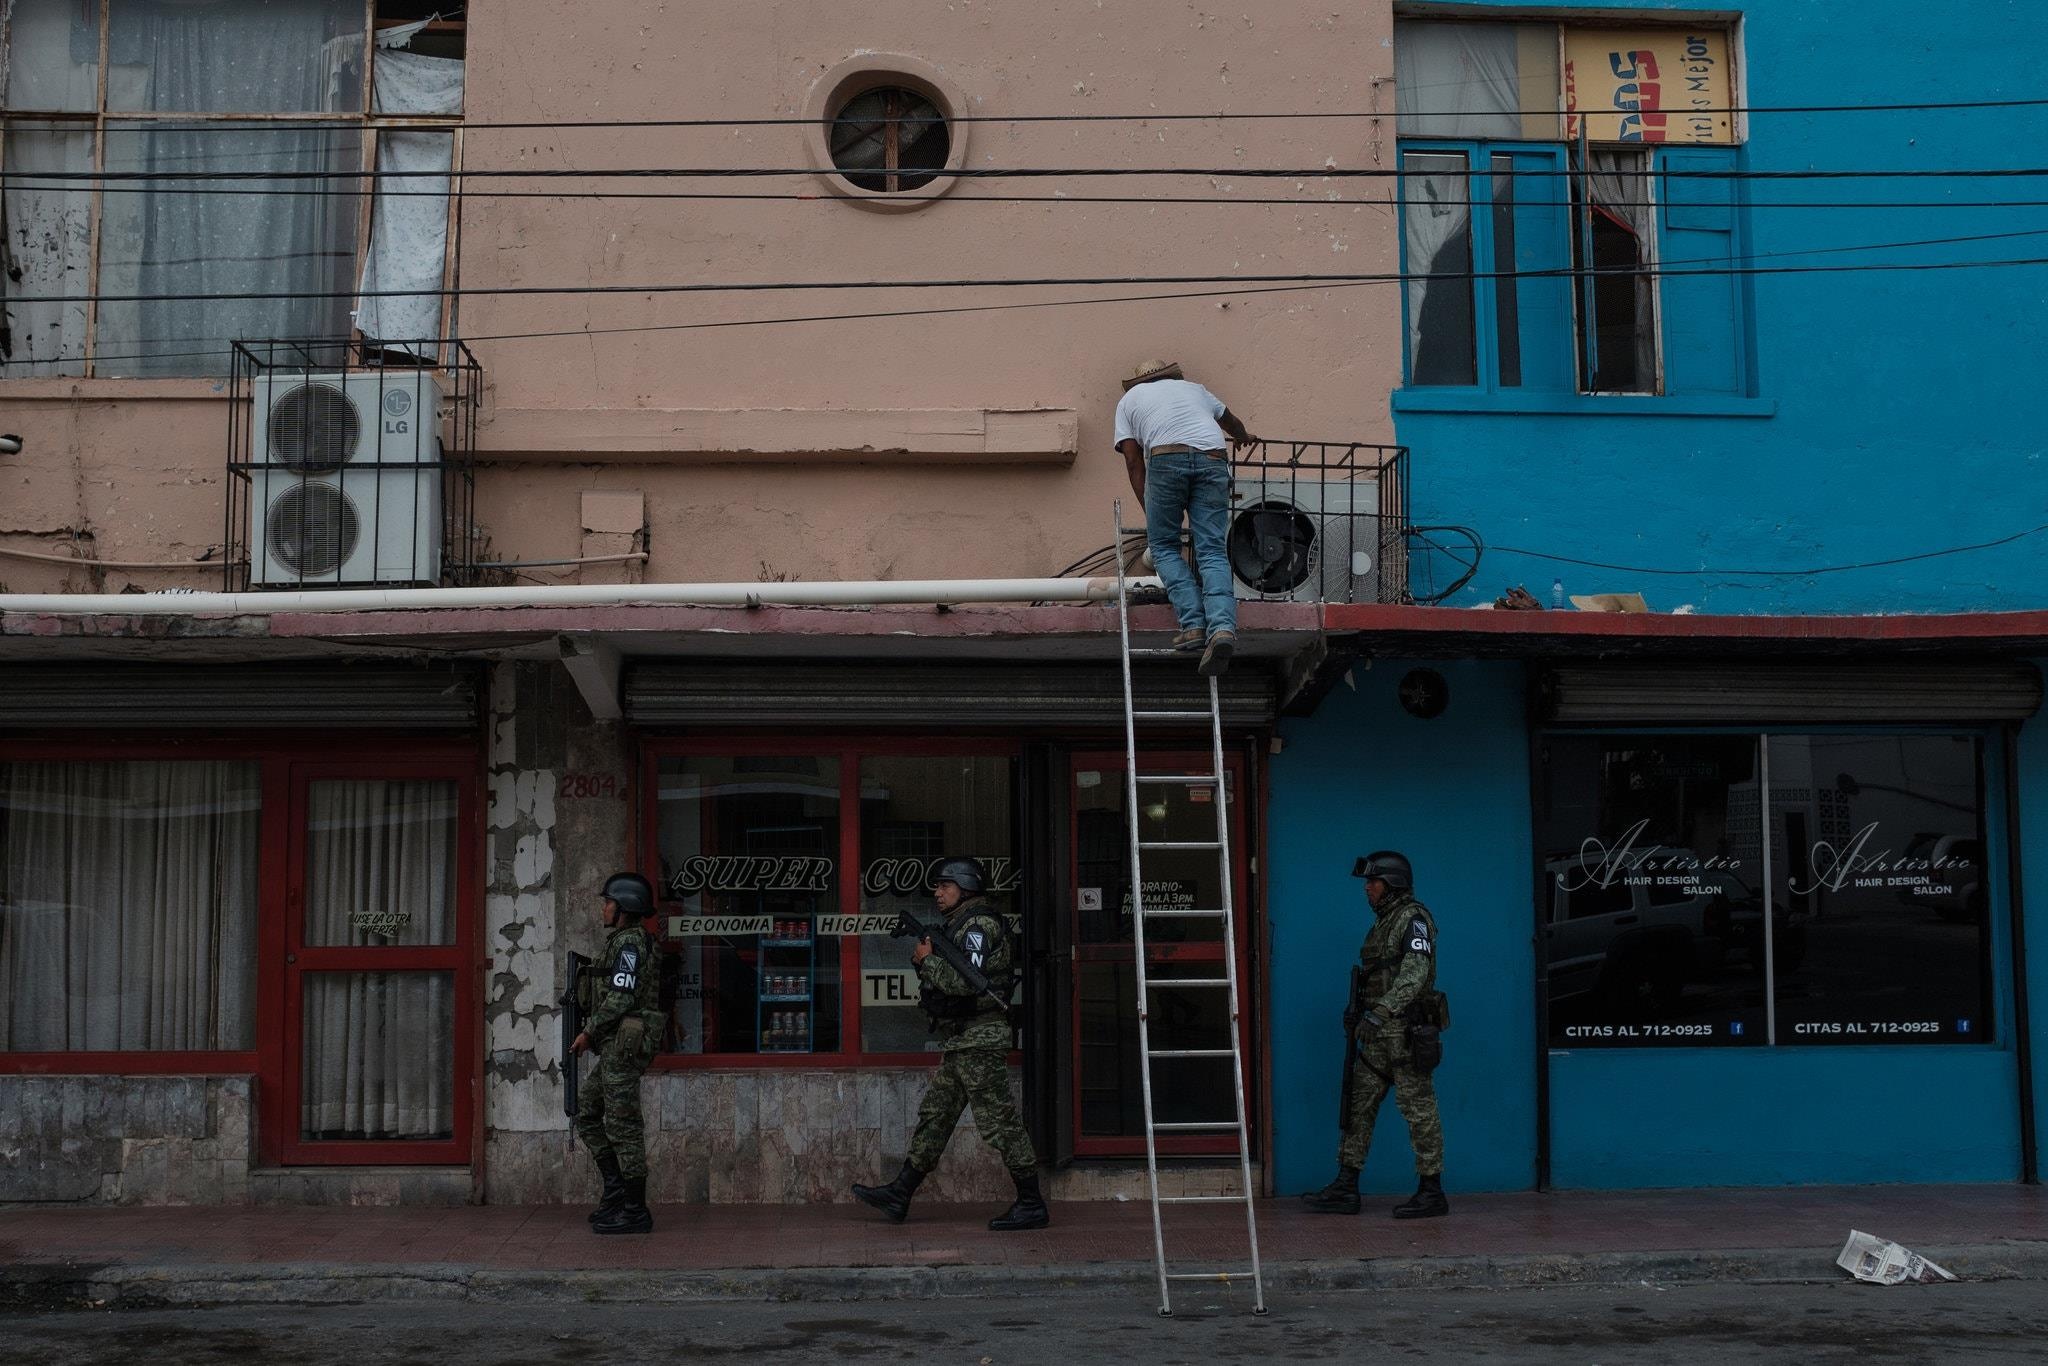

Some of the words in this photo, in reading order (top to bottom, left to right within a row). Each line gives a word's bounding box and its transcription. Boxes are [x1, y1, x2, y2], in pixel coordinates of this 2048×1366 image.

[1680, 35, 1714, 92] Mejor
[385, 420, 408, 434] LG
[560, 774, 615, 798] 2804
[671, 855, 833, 892] SUPER
[864, 856, 1023, 893] CON
[1136, 881, 1178, 892] ORARIO
[1624, 876, 1652, 886] HAIR
[1657, 876, 1700, 885] DESIGN
[1855, 878, 1883, 887] HAIR
[1887, 876, 1930, 886] DESIGN
[1683, 886, 1722, 895] SALON
[1913, 885, 1952, 895] SALON
[354, 913, 373, 923] USE
[372, 913, 384, 923] LA
[386, 913, 411, 923] OTRA
[359, 924, 399, 936] PUERTA
[680, 918, 770, 932] ECONOMIA
[1411, 938, 1431, 954] GN
[613, 972, 636, 990] GN
[673, 974, 700, 985] HILE
[866, 974, 919, 1000] TEL.
[1565, 1025, 1613, 1037] CITAS
[1617, 1025, 1639, 1036] AL
[1642, 1024, 1713, 1036] 712-0925
[1794, 1022, 1842, 1034] CITAS
[1846, 1022, 1867, 1033] AL
[1870, 1021, 1940, 1033] 712-0925
